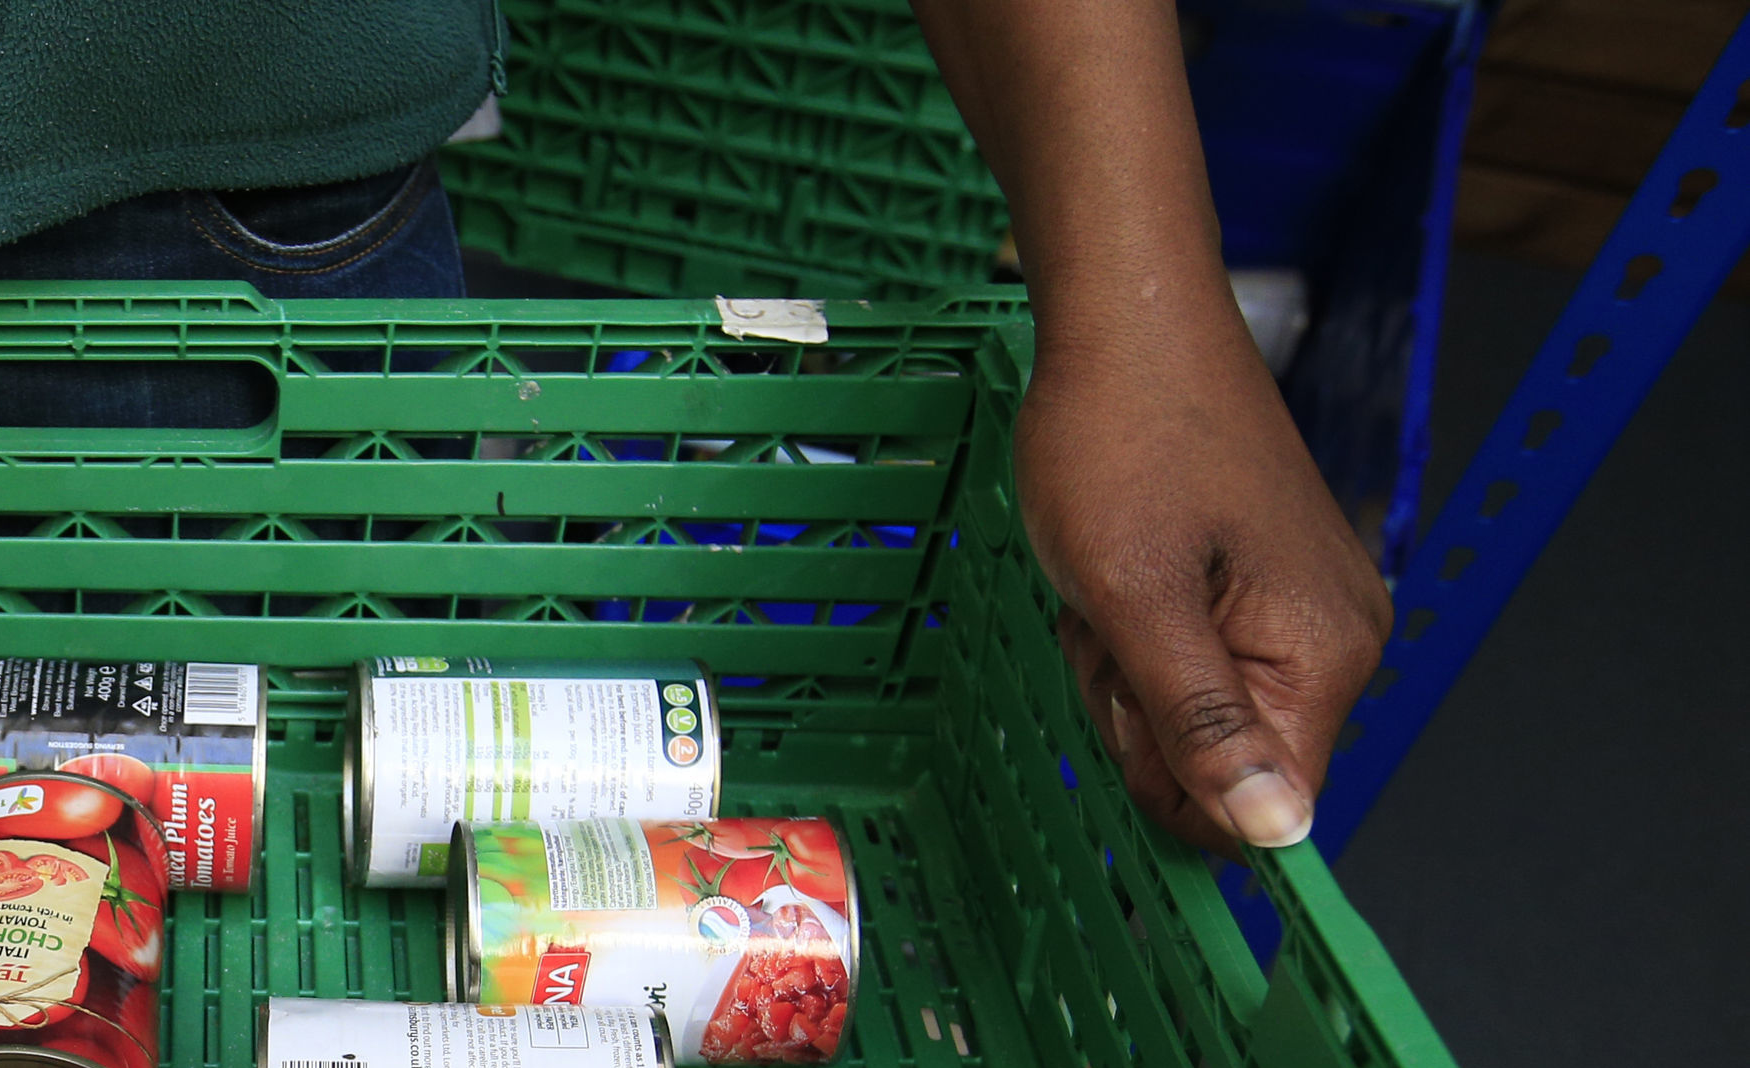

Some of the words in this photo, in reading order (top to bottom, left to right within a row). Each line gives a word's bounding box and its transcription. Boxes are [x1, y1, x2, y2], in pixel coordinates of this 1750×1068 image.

[97, 677, 116, 701] 400g
[684, 784, 703, 816] 400g
[163, 783, 188, 844] Plum
[224, 817, 238, 844] Juice
[189, 798, 216, 888] Tomatoes
[167, 851, 187, 887] eled
[223, 845, 236, 873] Tomato
[37, 906, 60, 918] rich
[62, 914, 74, 925] in
[423, 1036, 432, 1048] out
[632, 1029, 642, 1051] counts
[490, 1049, 498, 1060] full
[499, 1046, 508, 1059] you
[511, 1047, 520, 1065] you'll
[624, 1041, 633, 1068] different
[635, 1053, 643, 1062] as
